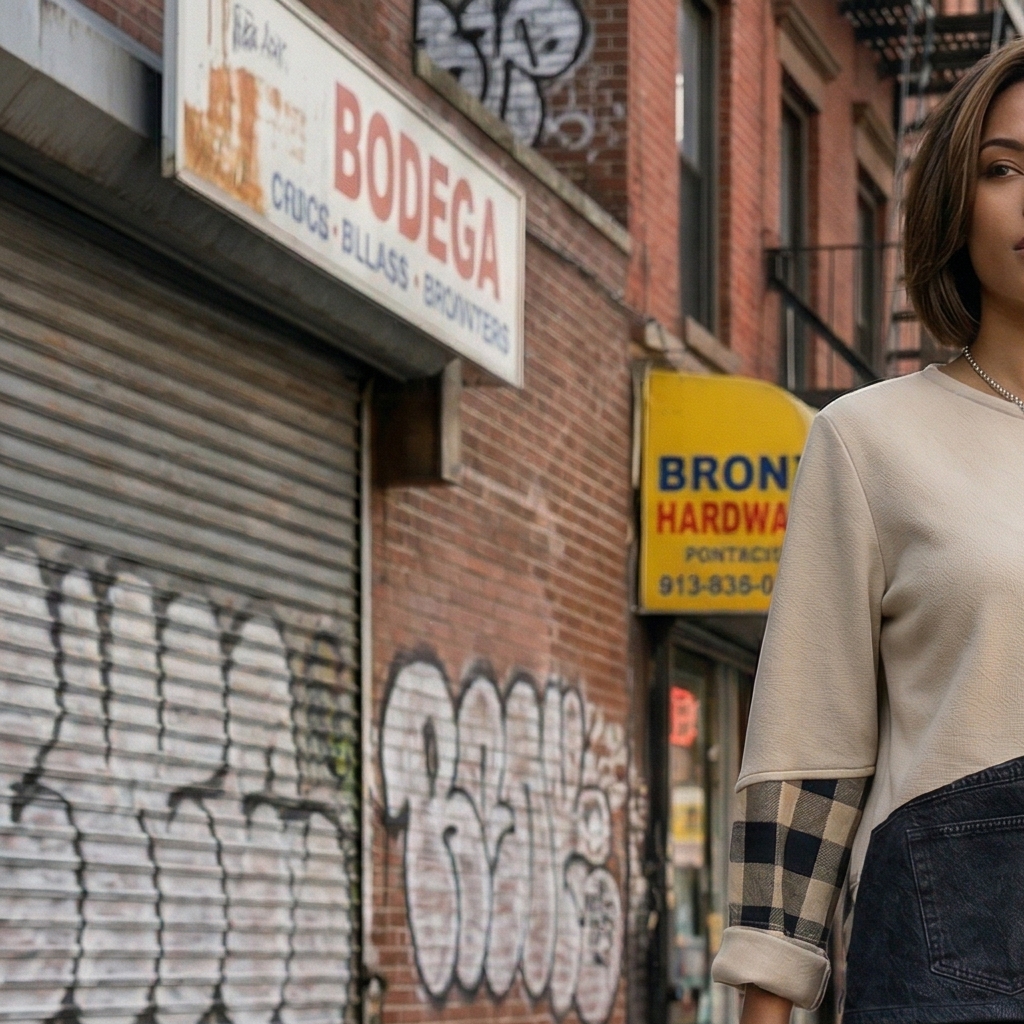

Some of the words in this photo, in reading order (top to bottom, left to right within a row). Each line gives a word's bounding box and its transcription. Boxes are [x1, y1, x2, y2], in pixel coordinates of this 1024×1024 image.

[333, 80, 500, 301] BODEGA
[658, 454, 803, 491] BRON
[656, 501, 787, 535] HARDWA
